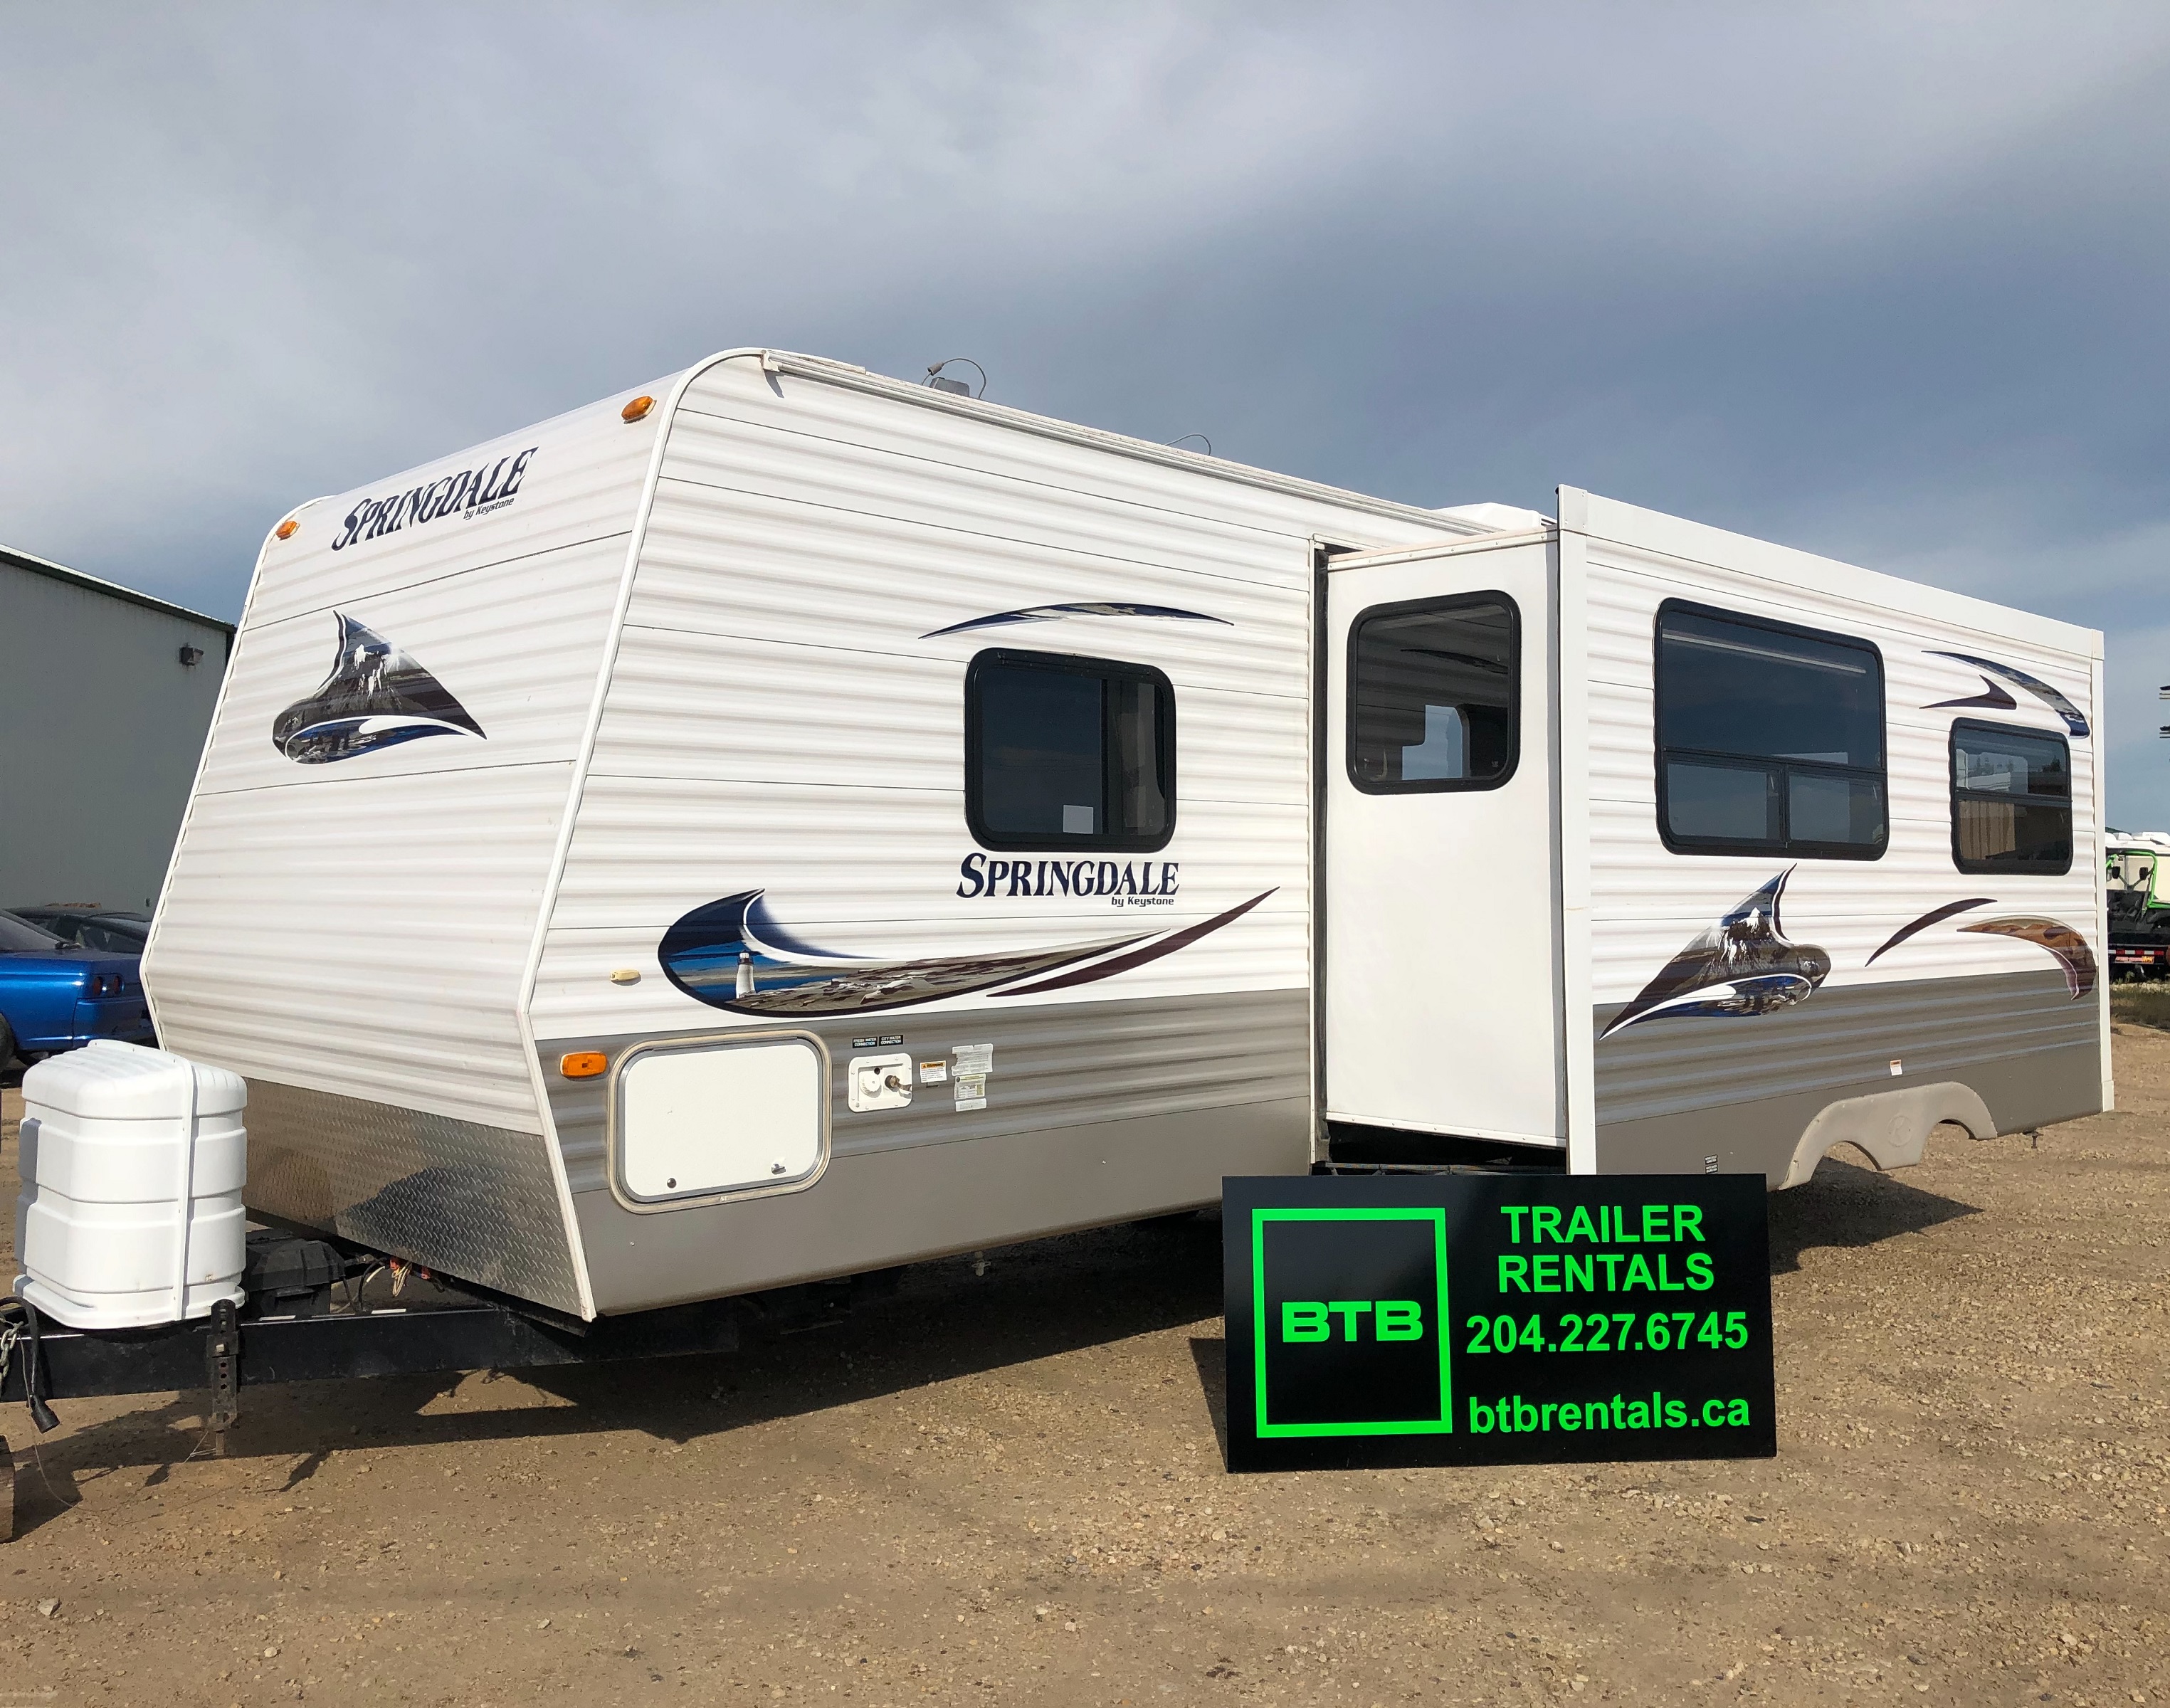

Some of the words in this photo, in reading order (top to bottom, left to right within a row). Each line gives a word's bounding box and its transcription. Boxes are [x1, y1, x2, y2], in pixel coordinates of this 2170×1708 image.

[331, 446, 539, 551] SPRINGDALE
[463, 508, 474, 520] by
[475, 497, 515, 516] Keystone
[956, 852, 1180, 898] SPRINGDALE
[1111, 896, 1124, 907] by
[1127, 896, 1174, 907] Keystone
[1500, 1204, 1706, 1244] TRAILER
[1497, 1252, 1715, 1294] RENTALS
[1281, 1300, 1423, 1343] BTB
[1466, 1311, 1749, 1354] 204.227.6745
[1469, 1391, 1750, 1434] btbrentals.ca
